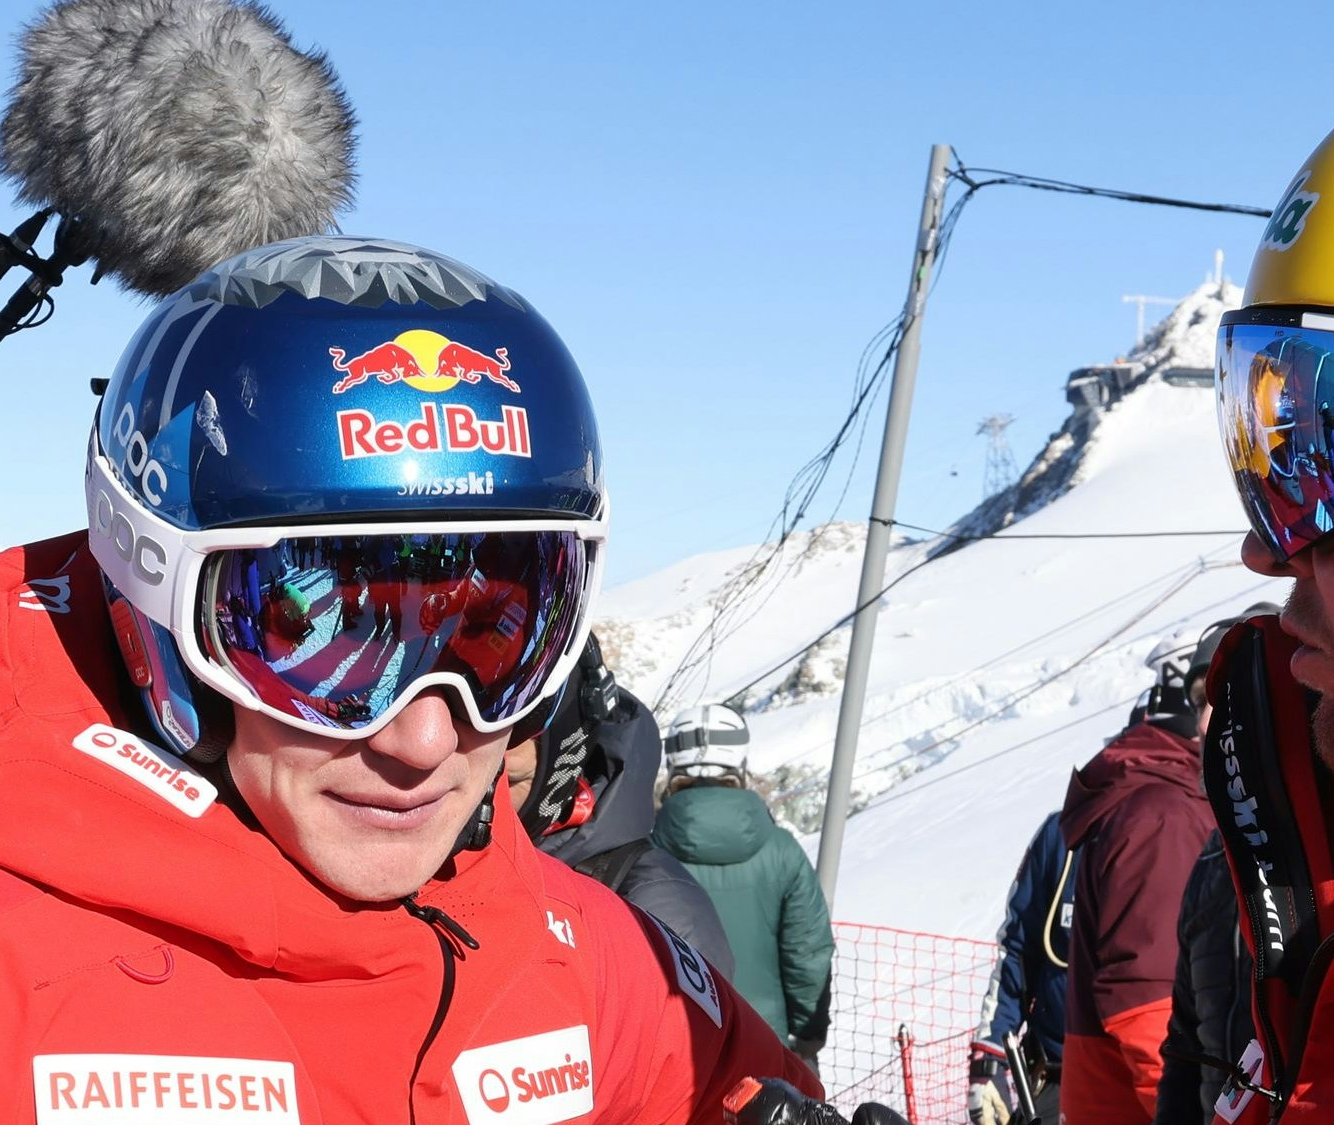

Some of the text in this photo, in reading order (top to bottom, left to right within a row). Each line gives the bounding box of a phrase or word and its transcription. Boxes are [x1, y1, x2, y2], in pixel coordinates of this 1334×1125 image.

[113, 402, 168, 506] poc
[338, 403, 530, 458] Red Bull
[96, 489, 167, 586] poc
[117, 743, 200, 801] Sunrise
[49, 1071, 288, 1113] RAIFFEISEN
[511, 1053, 590, 1103] Sunrise
